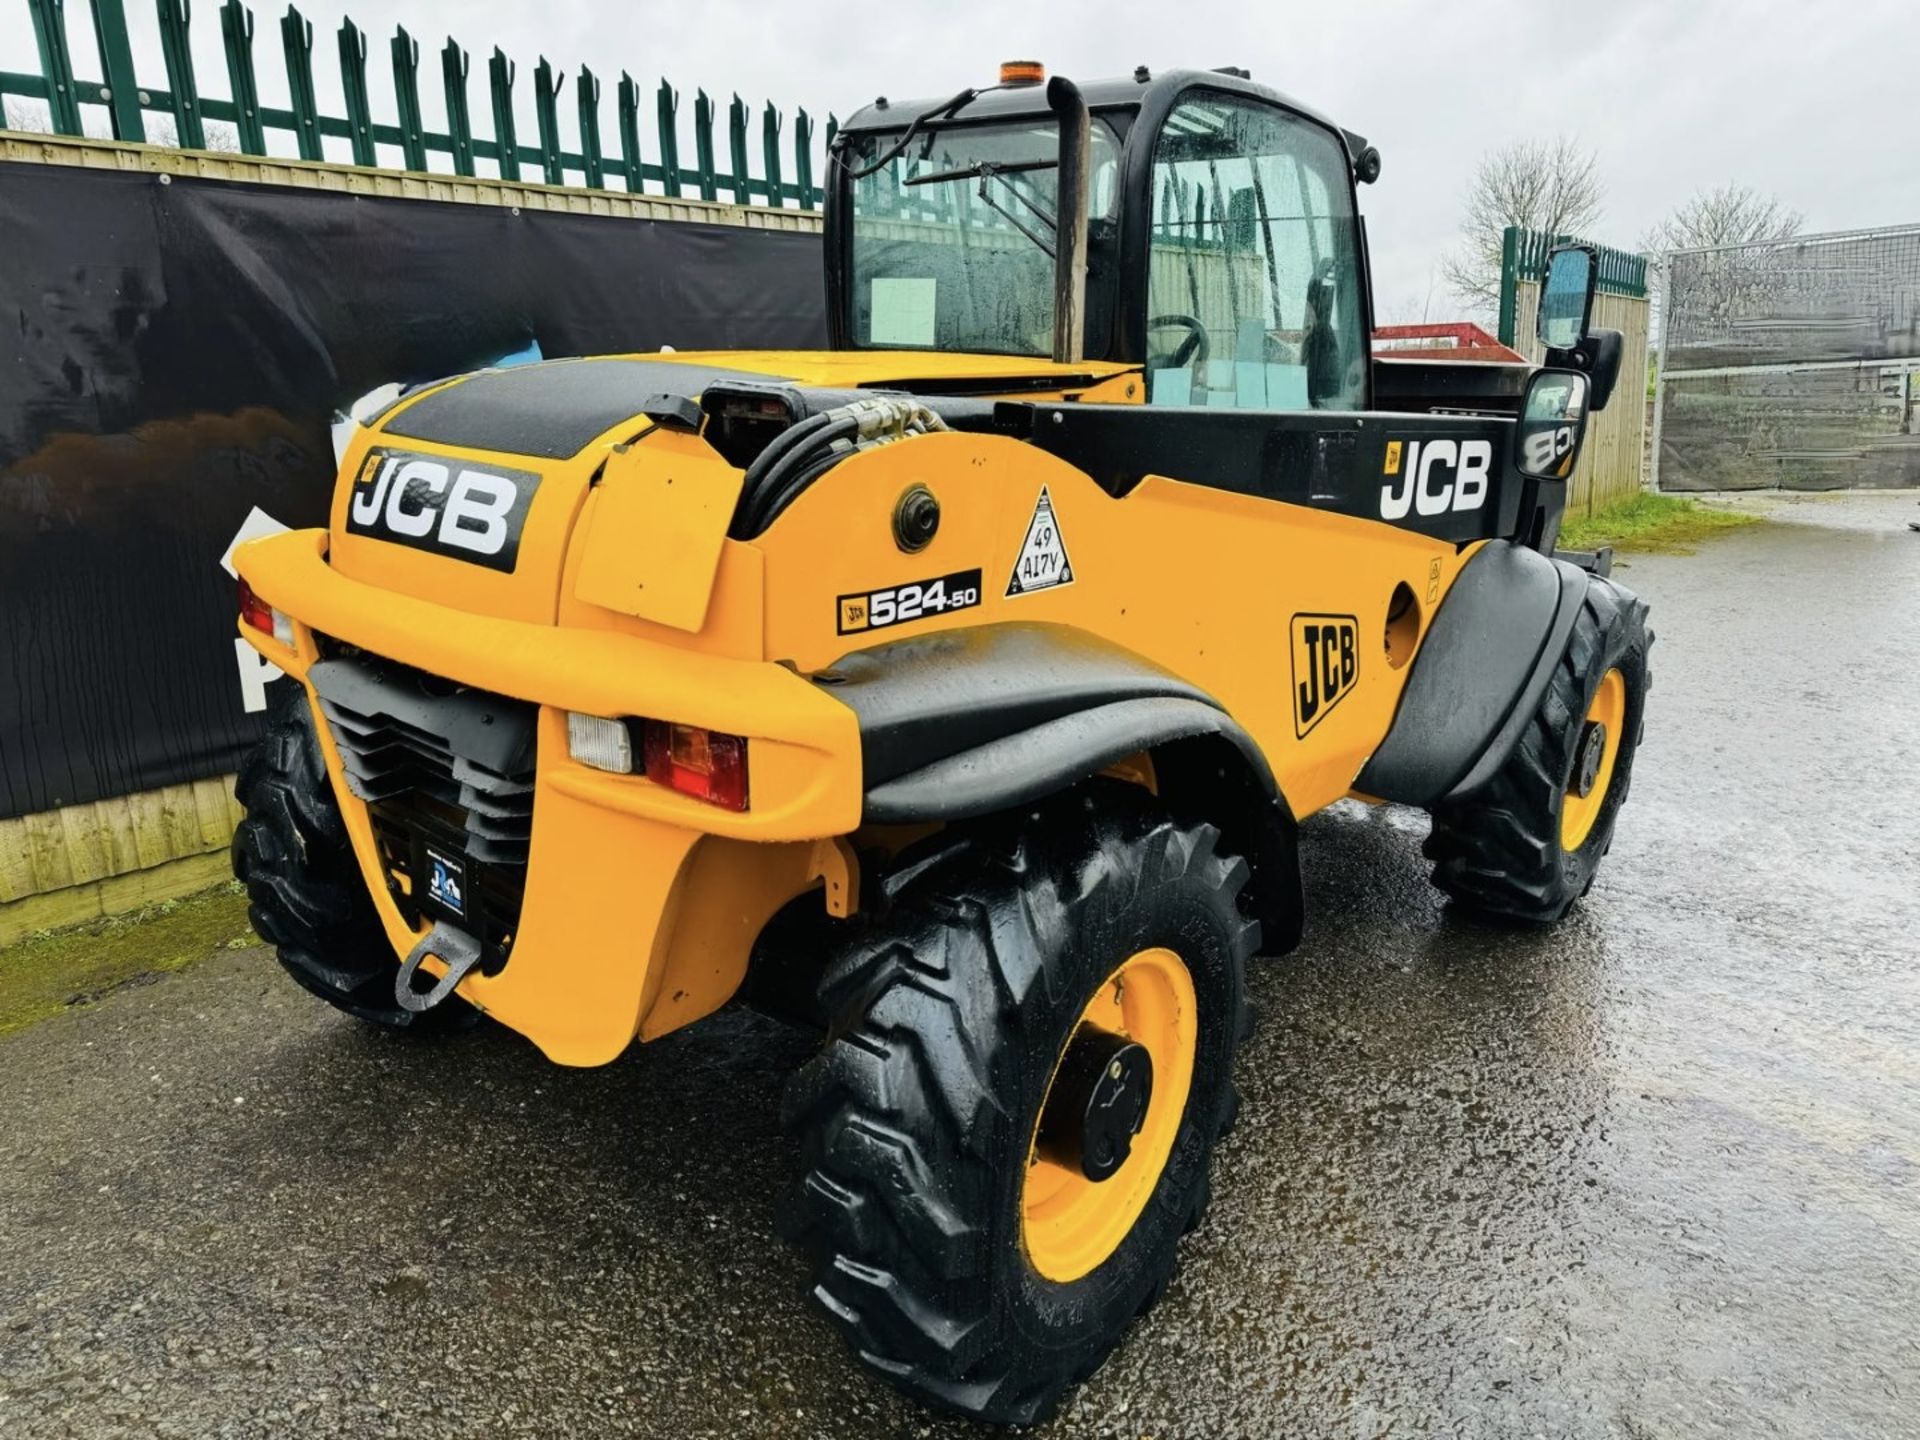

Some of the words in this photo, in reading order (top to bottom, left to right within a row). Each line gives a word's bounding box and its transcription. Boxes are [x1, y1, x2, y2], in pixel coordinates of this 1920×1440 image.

[352, 458, 517, 555] JCB
[1380, 440, 1492, 520] JCB
[1034, 527, 1052, 550] 49
[1299, 625, 1355, 724] JCB
